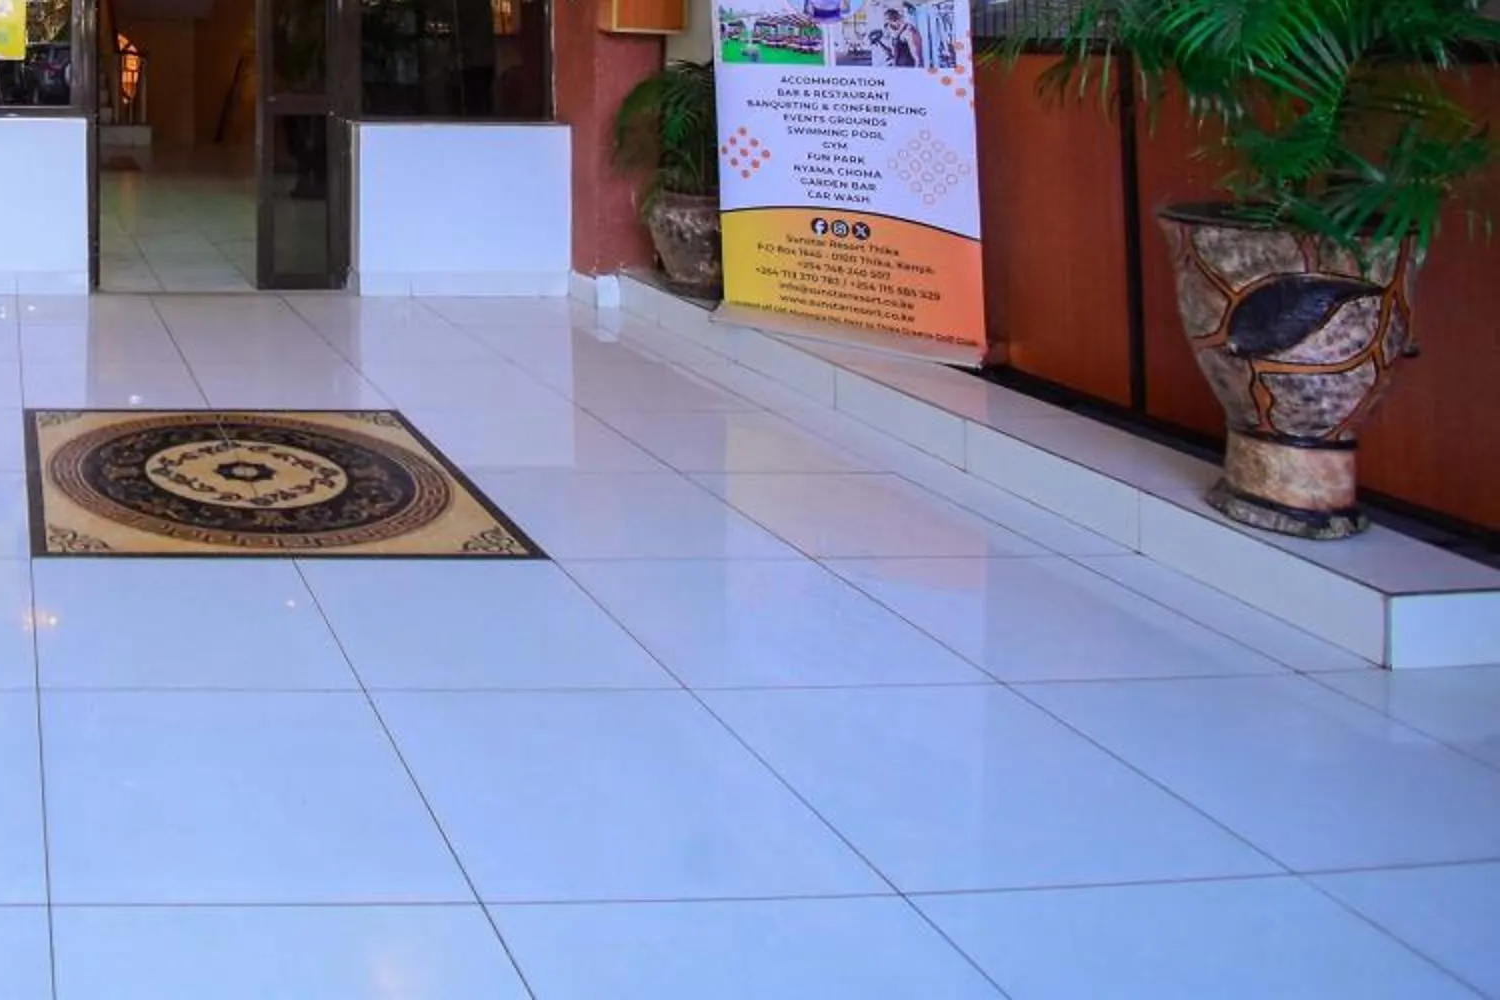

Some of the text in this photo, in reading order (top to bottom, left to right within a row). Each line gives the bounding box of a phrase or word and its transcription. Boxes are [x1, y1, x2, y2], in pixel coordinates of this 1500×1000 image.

[780, 76, 886, 87] ACCOMMODATION
[777, 88, 890, 101] BAR & RESTAURANT
[747, 100, 819, 111] BANQUETING
[833, 104, 928, 117] CONFERENCING
[783, 114, 888, 127] EVENTS GROUNDS
[787, 126, 885, 140] SWIMMING POOL
[822, 142, 848, 150] GYM
[807, 152, 865, 164] FUN PARK
[793, 165, 883, 179] NYAMA CHOMA
[800, 177, 877, 191] GARDEN BAR
[807, 191, 871, 204] CAR WASH
